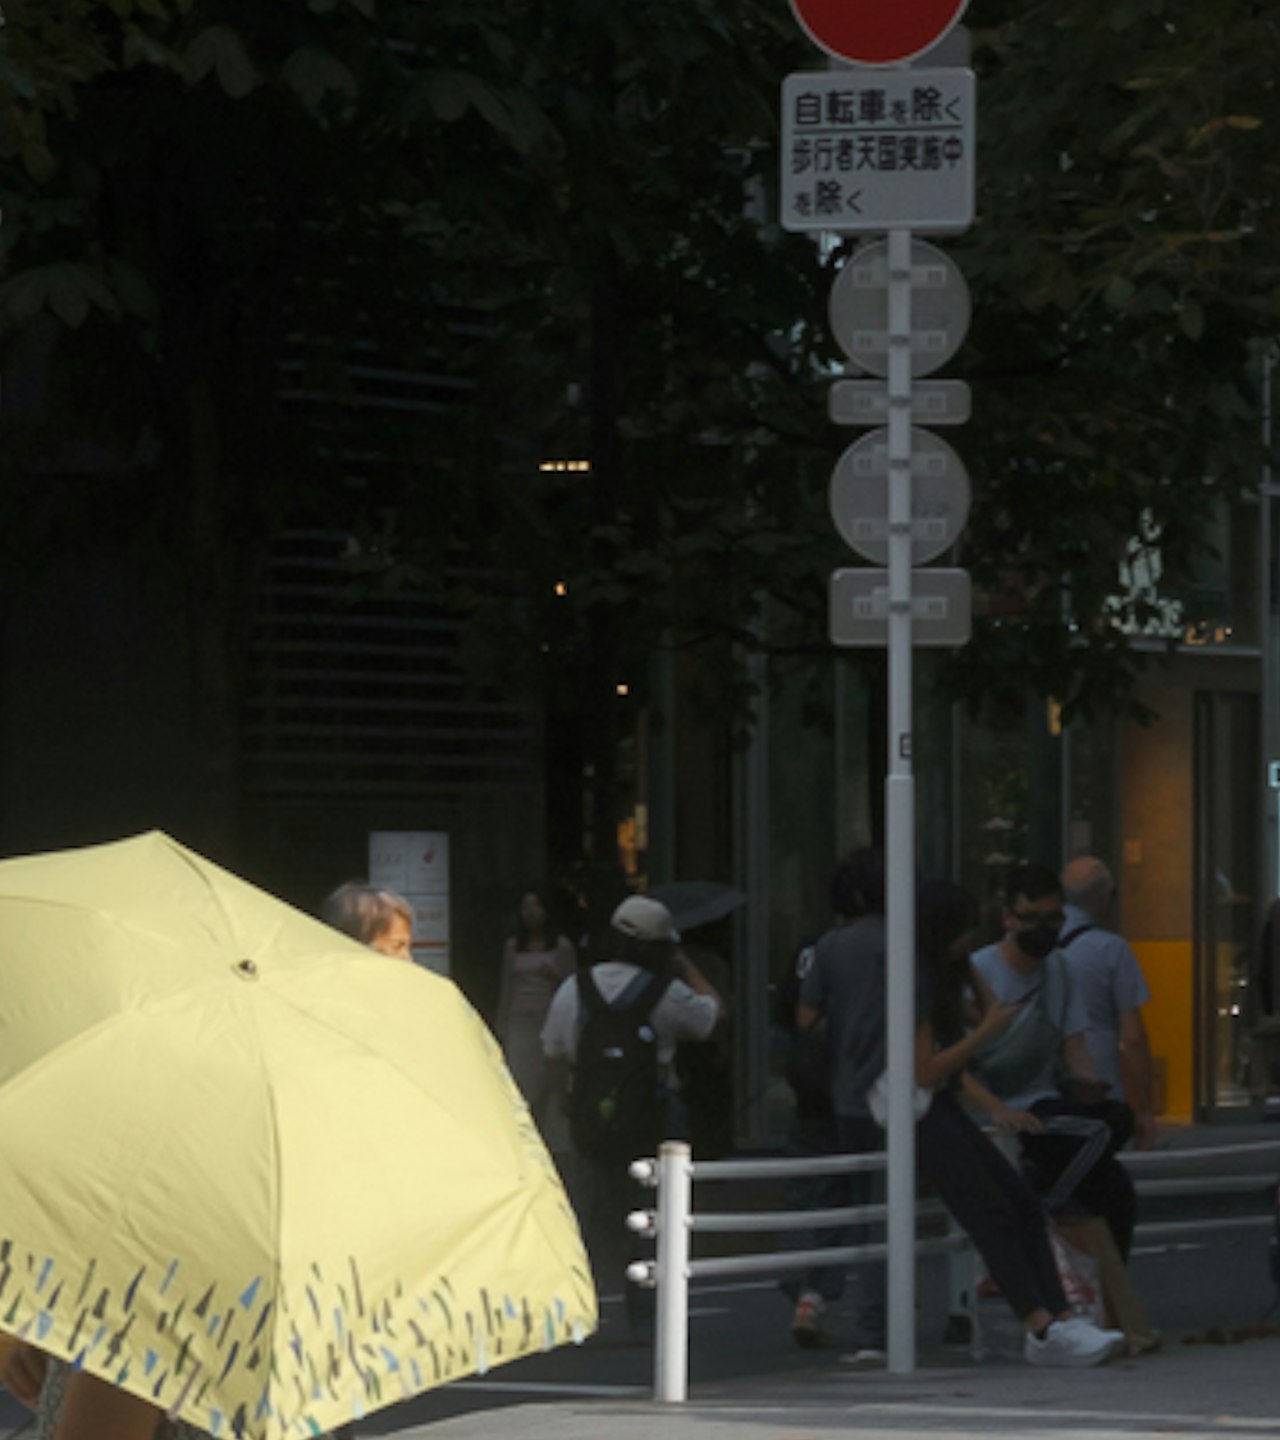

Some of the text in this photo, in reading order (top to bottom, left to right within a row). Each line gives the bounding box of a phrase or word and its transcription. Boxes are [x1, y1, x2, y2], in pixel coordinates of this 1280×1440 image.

[795, 86, 962, 125] 自転車を除く
[793, 135, 963, 174] 歩行者天国実施中
[794, 180, 862, 217] を除く
